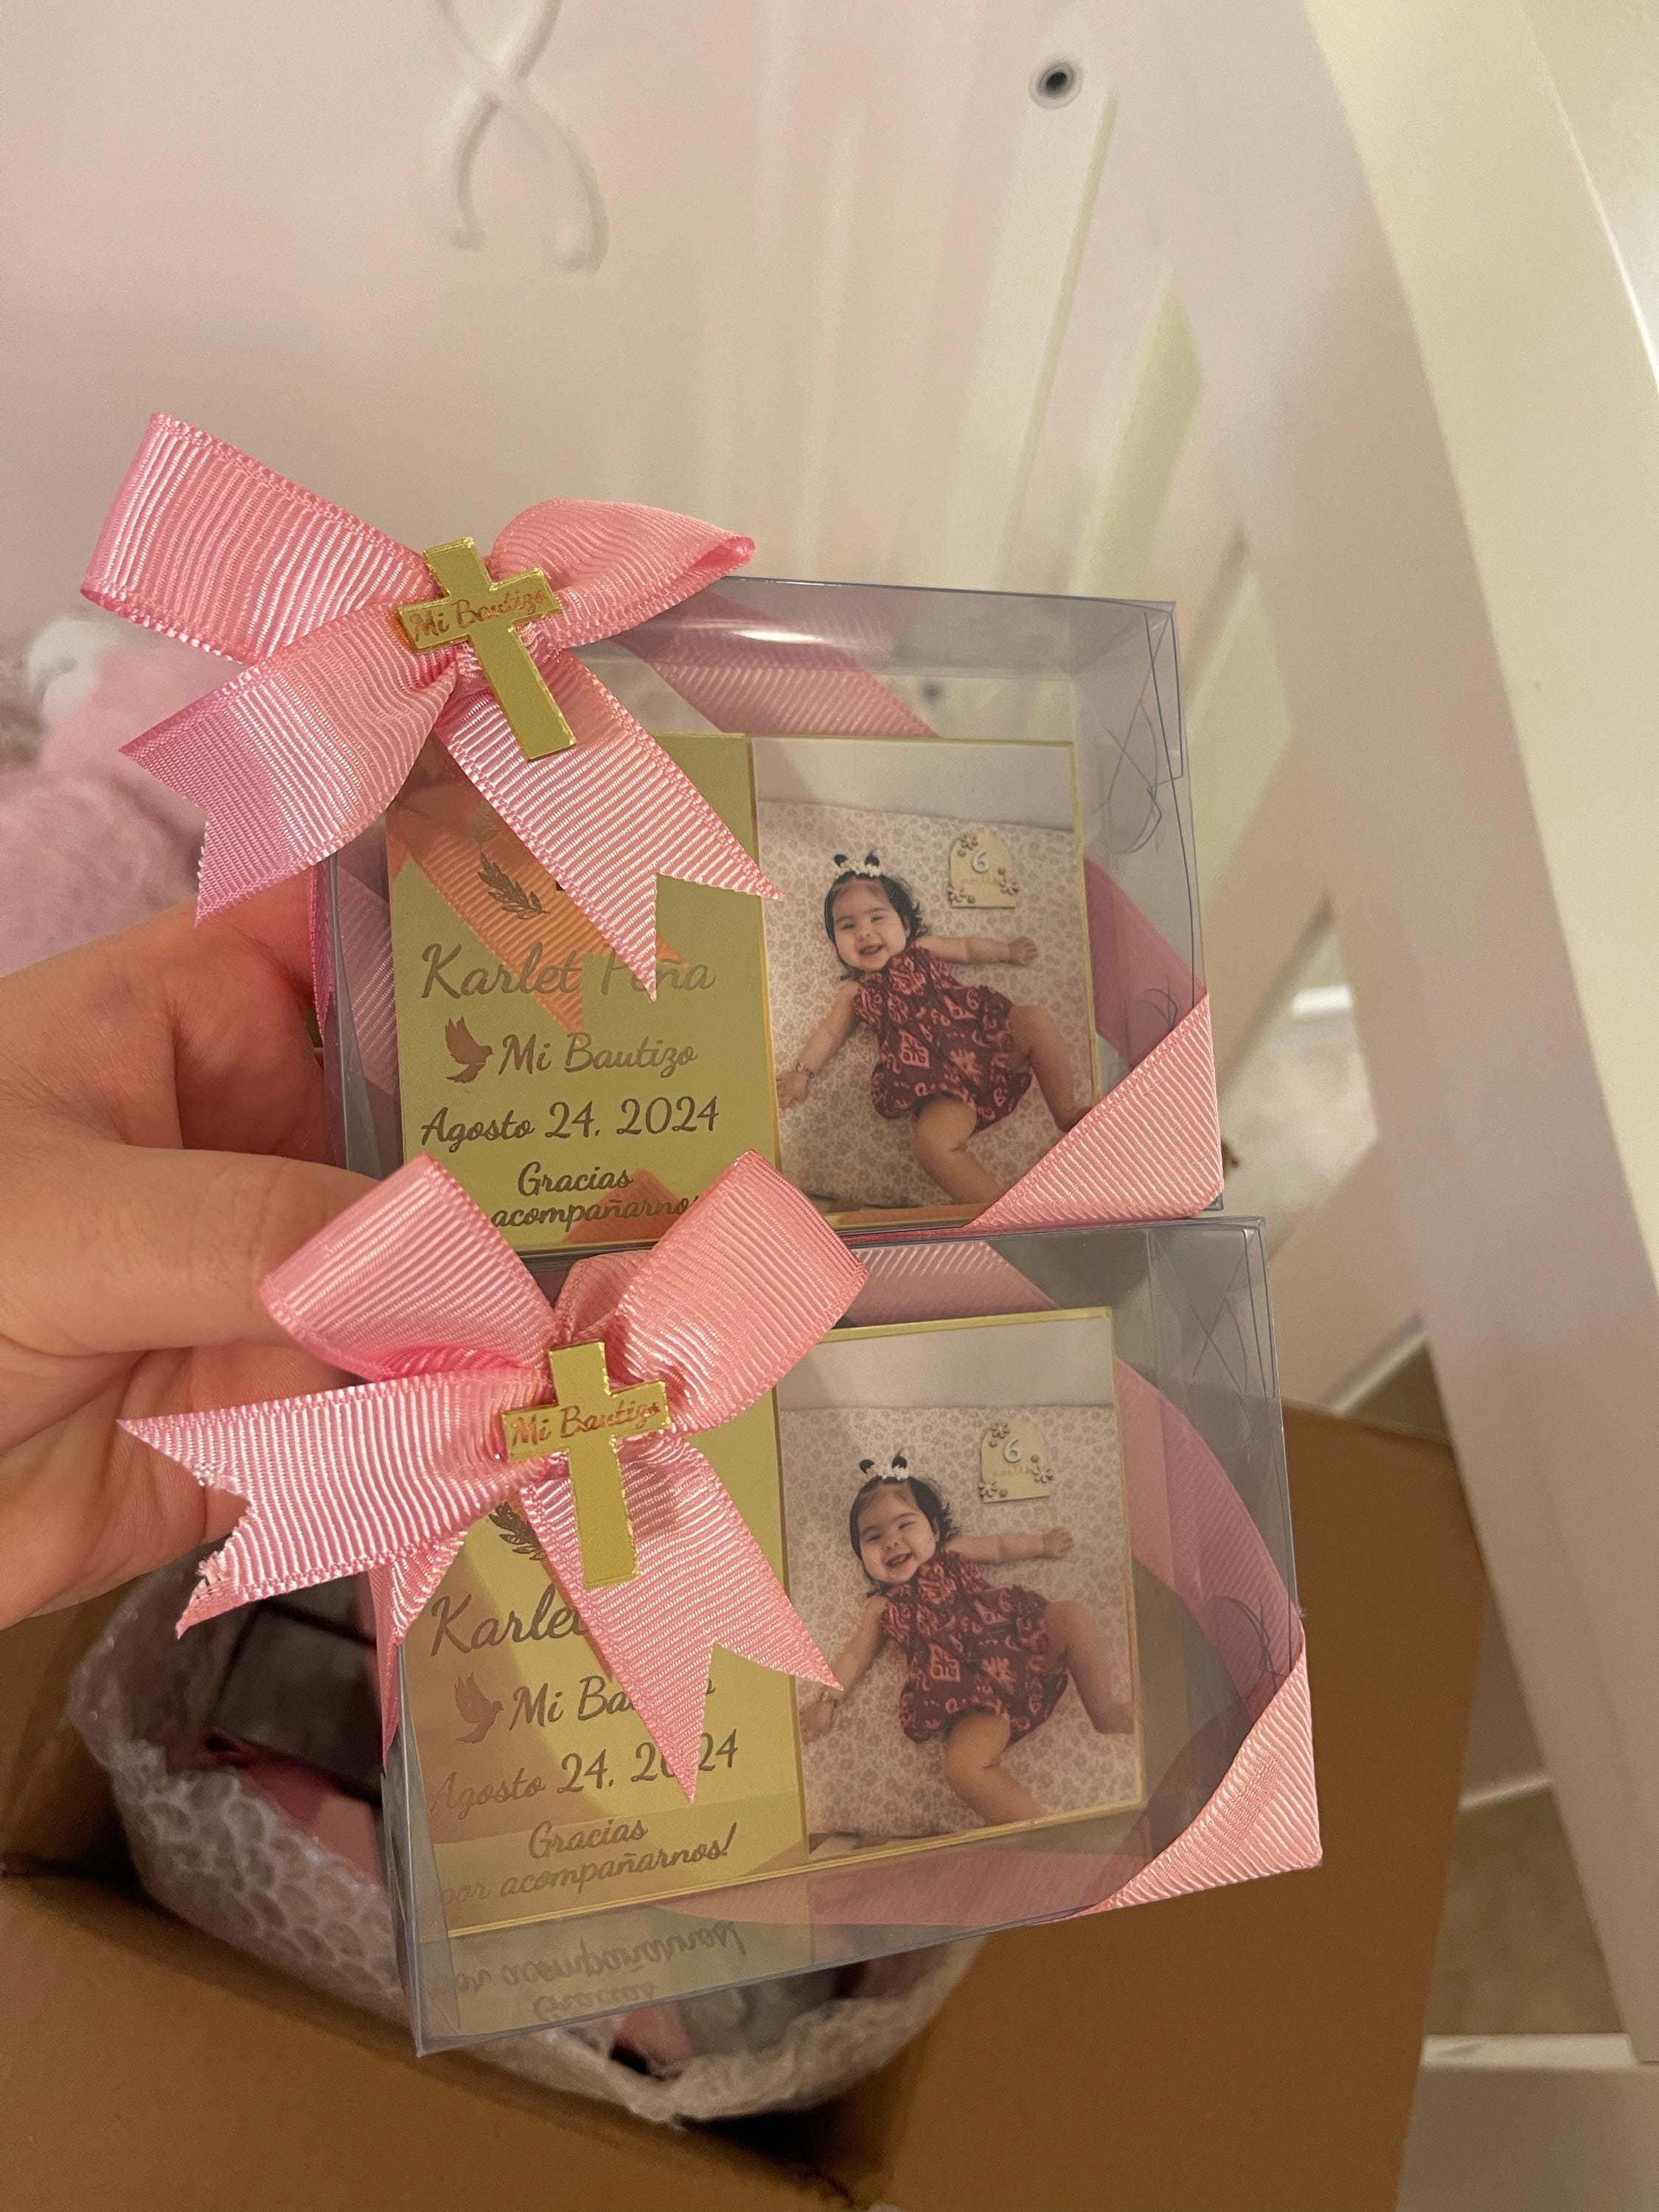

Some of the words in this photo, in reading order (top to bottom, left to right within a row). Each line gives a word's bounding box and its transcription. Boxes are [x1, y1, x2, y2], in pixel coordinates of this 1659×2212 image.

[409, 610, 451, 642] Mi
[450, 590, 547, 628] Bautizo
[971, 851, 990, 874] 6
[421, 942, 583, 1000] Karlet
[498, 1032, 553, 1076] Mi
[563, 1032, 699, 1078] Bautizo
[421, 1106, 537, 1153] Agosto
[616, 1095, 720, 1135] 2024
[518, 1161, 634, 1197] Gracias
[490, 1194, 699, 1233] acompañarno
[511, 1413, 552, 1447] Mi
[560, 1399, 661, 1438] Bautizo
[1003, 1438, 1023, 1464] 6
[509, 1682, 564, 1732] Mi
[428, 1767, 546, 1821] Agosto
[499, 1821, 738, 1895] acompañarnos!
[528, 1818, 649, 1860] Gracias
